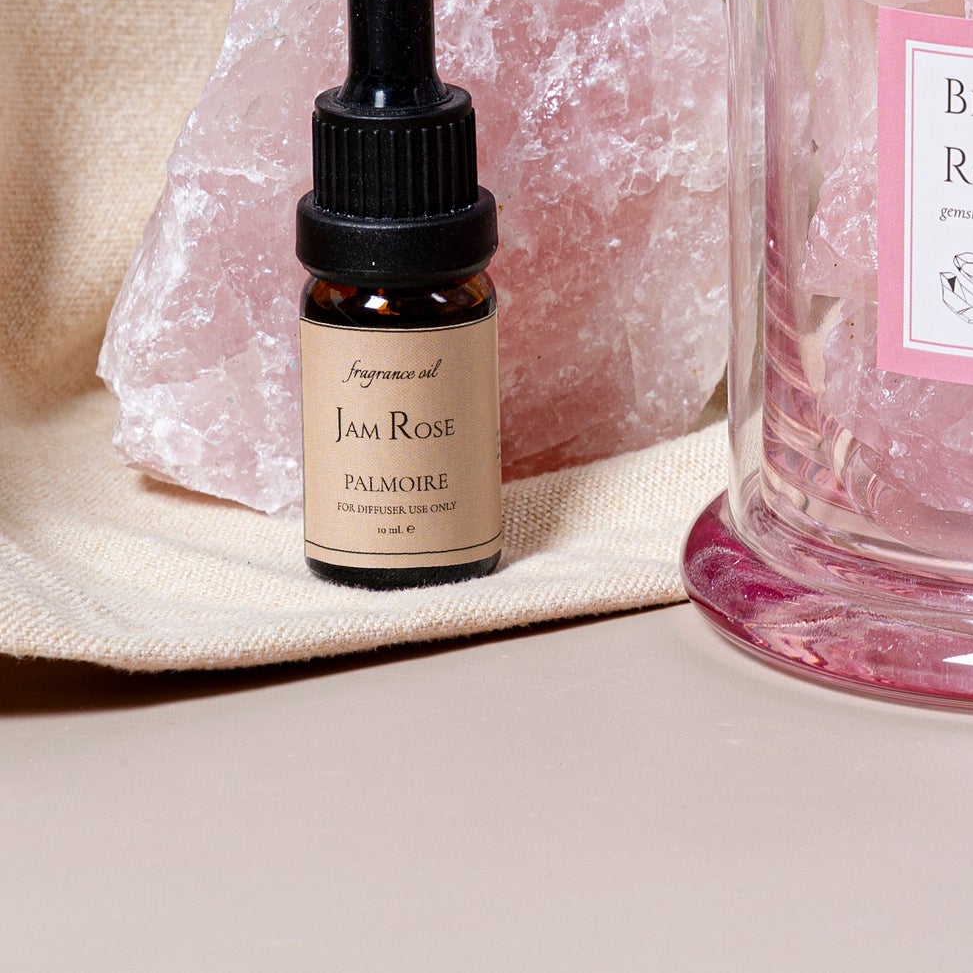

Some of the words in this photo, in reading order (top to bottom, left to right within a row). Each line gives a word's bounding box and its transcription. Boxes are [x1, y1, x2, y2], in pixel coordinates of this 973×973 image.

[341, 359, 417, 389] fragrance
[418, 358, 443, 379] oil
[344, 473, 449, 493] PALMOIRE
[337, 501, 356, 513] FOR
[357, 504, 407, 515] DIFFUSER
[408, 504, 428, 515] USE
[430, 501, 457, 513] ONLY
[377, 526, 387, 534] 10
